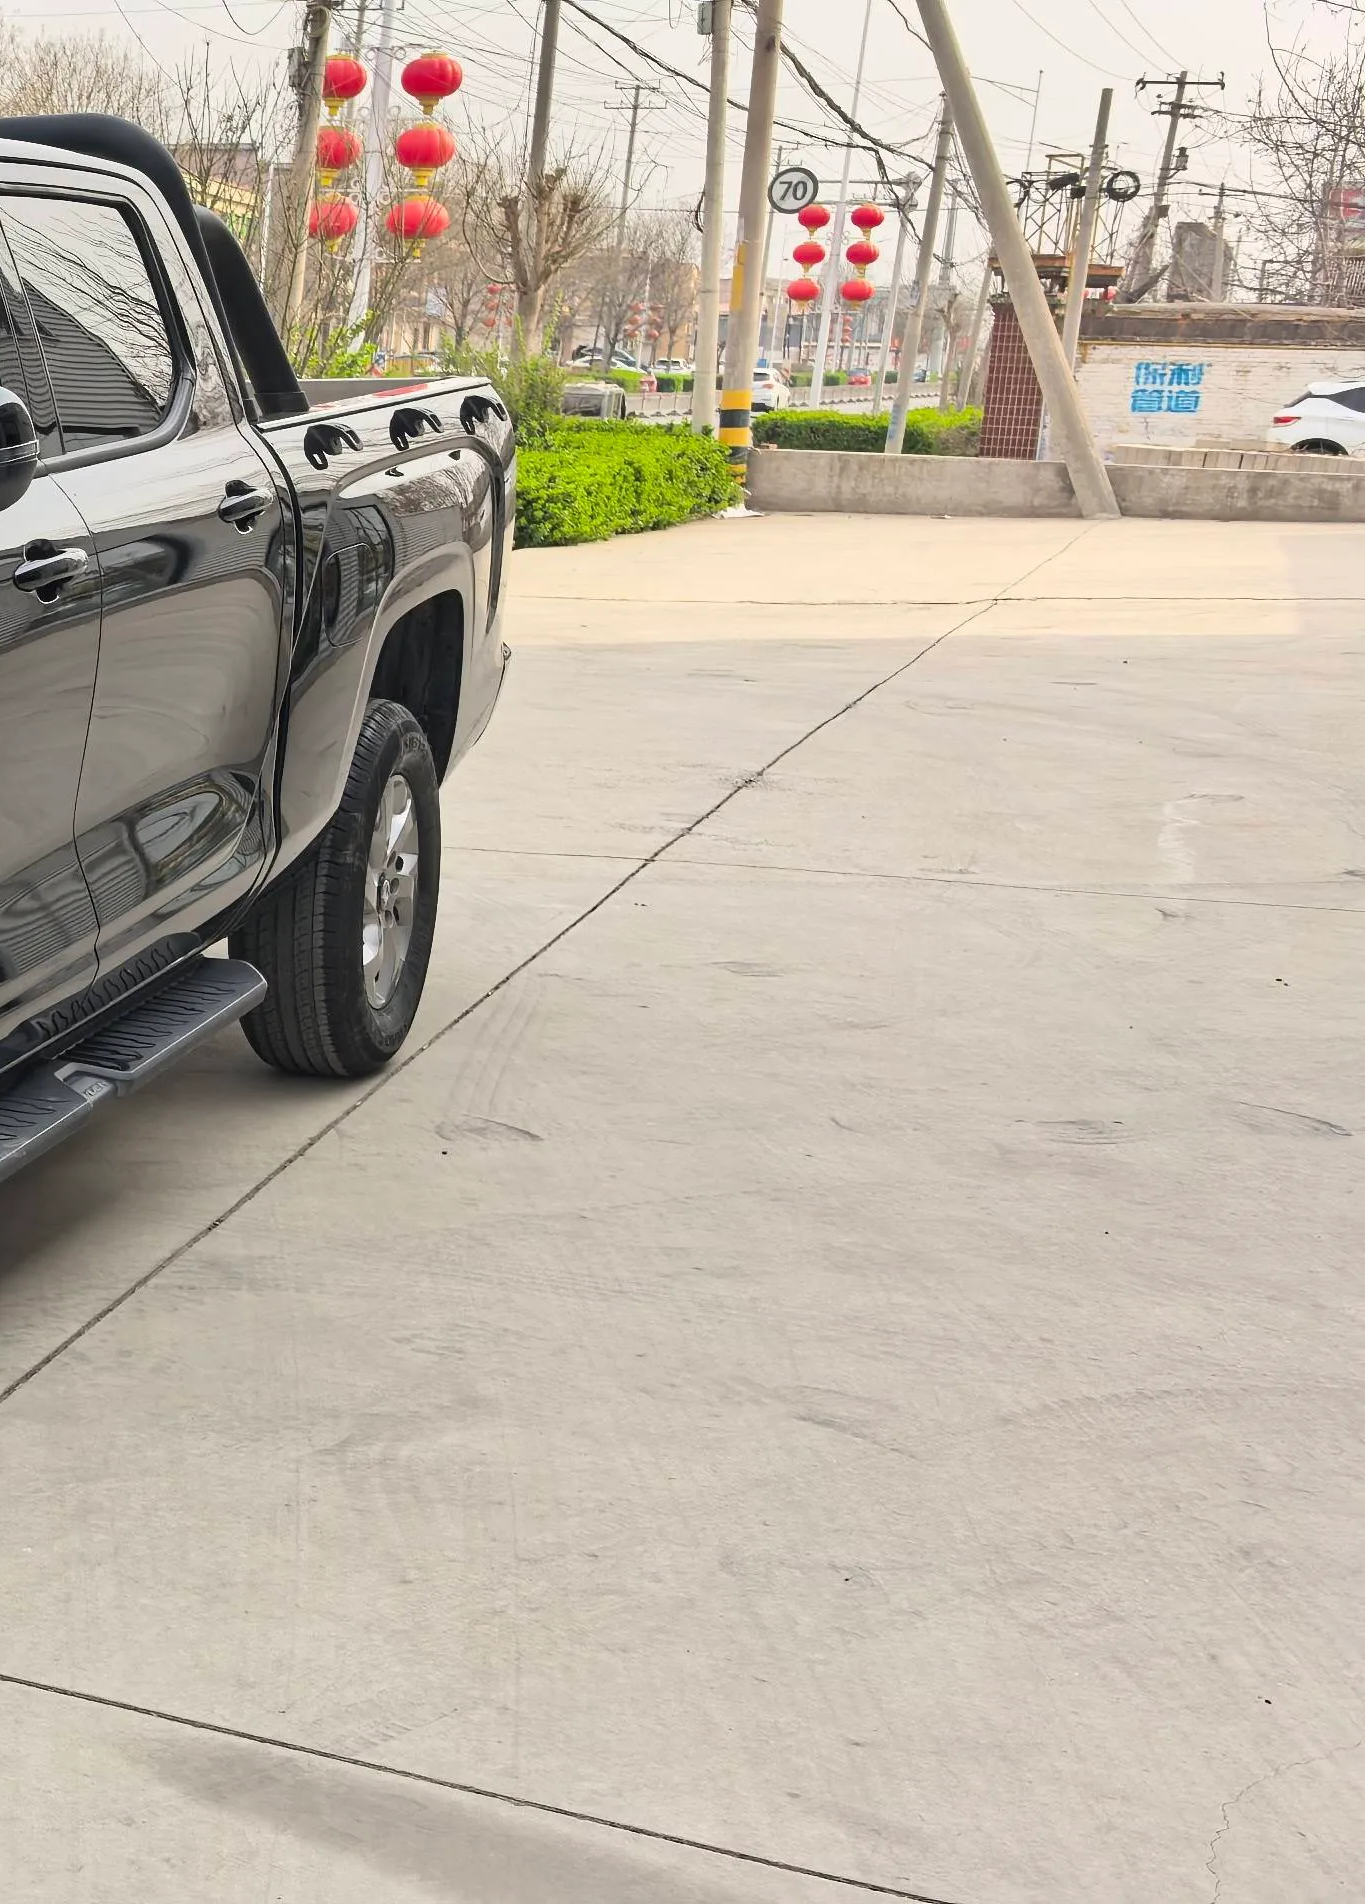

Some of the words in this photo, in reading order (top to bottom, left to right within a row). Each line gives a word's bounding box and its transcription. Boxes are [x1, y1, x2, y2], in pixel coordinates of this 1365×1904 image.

[779, 181, 808, 201] 70
[1135, 361, 1205, 386] 保利
[1130, 388, 1202, 413] 管道
